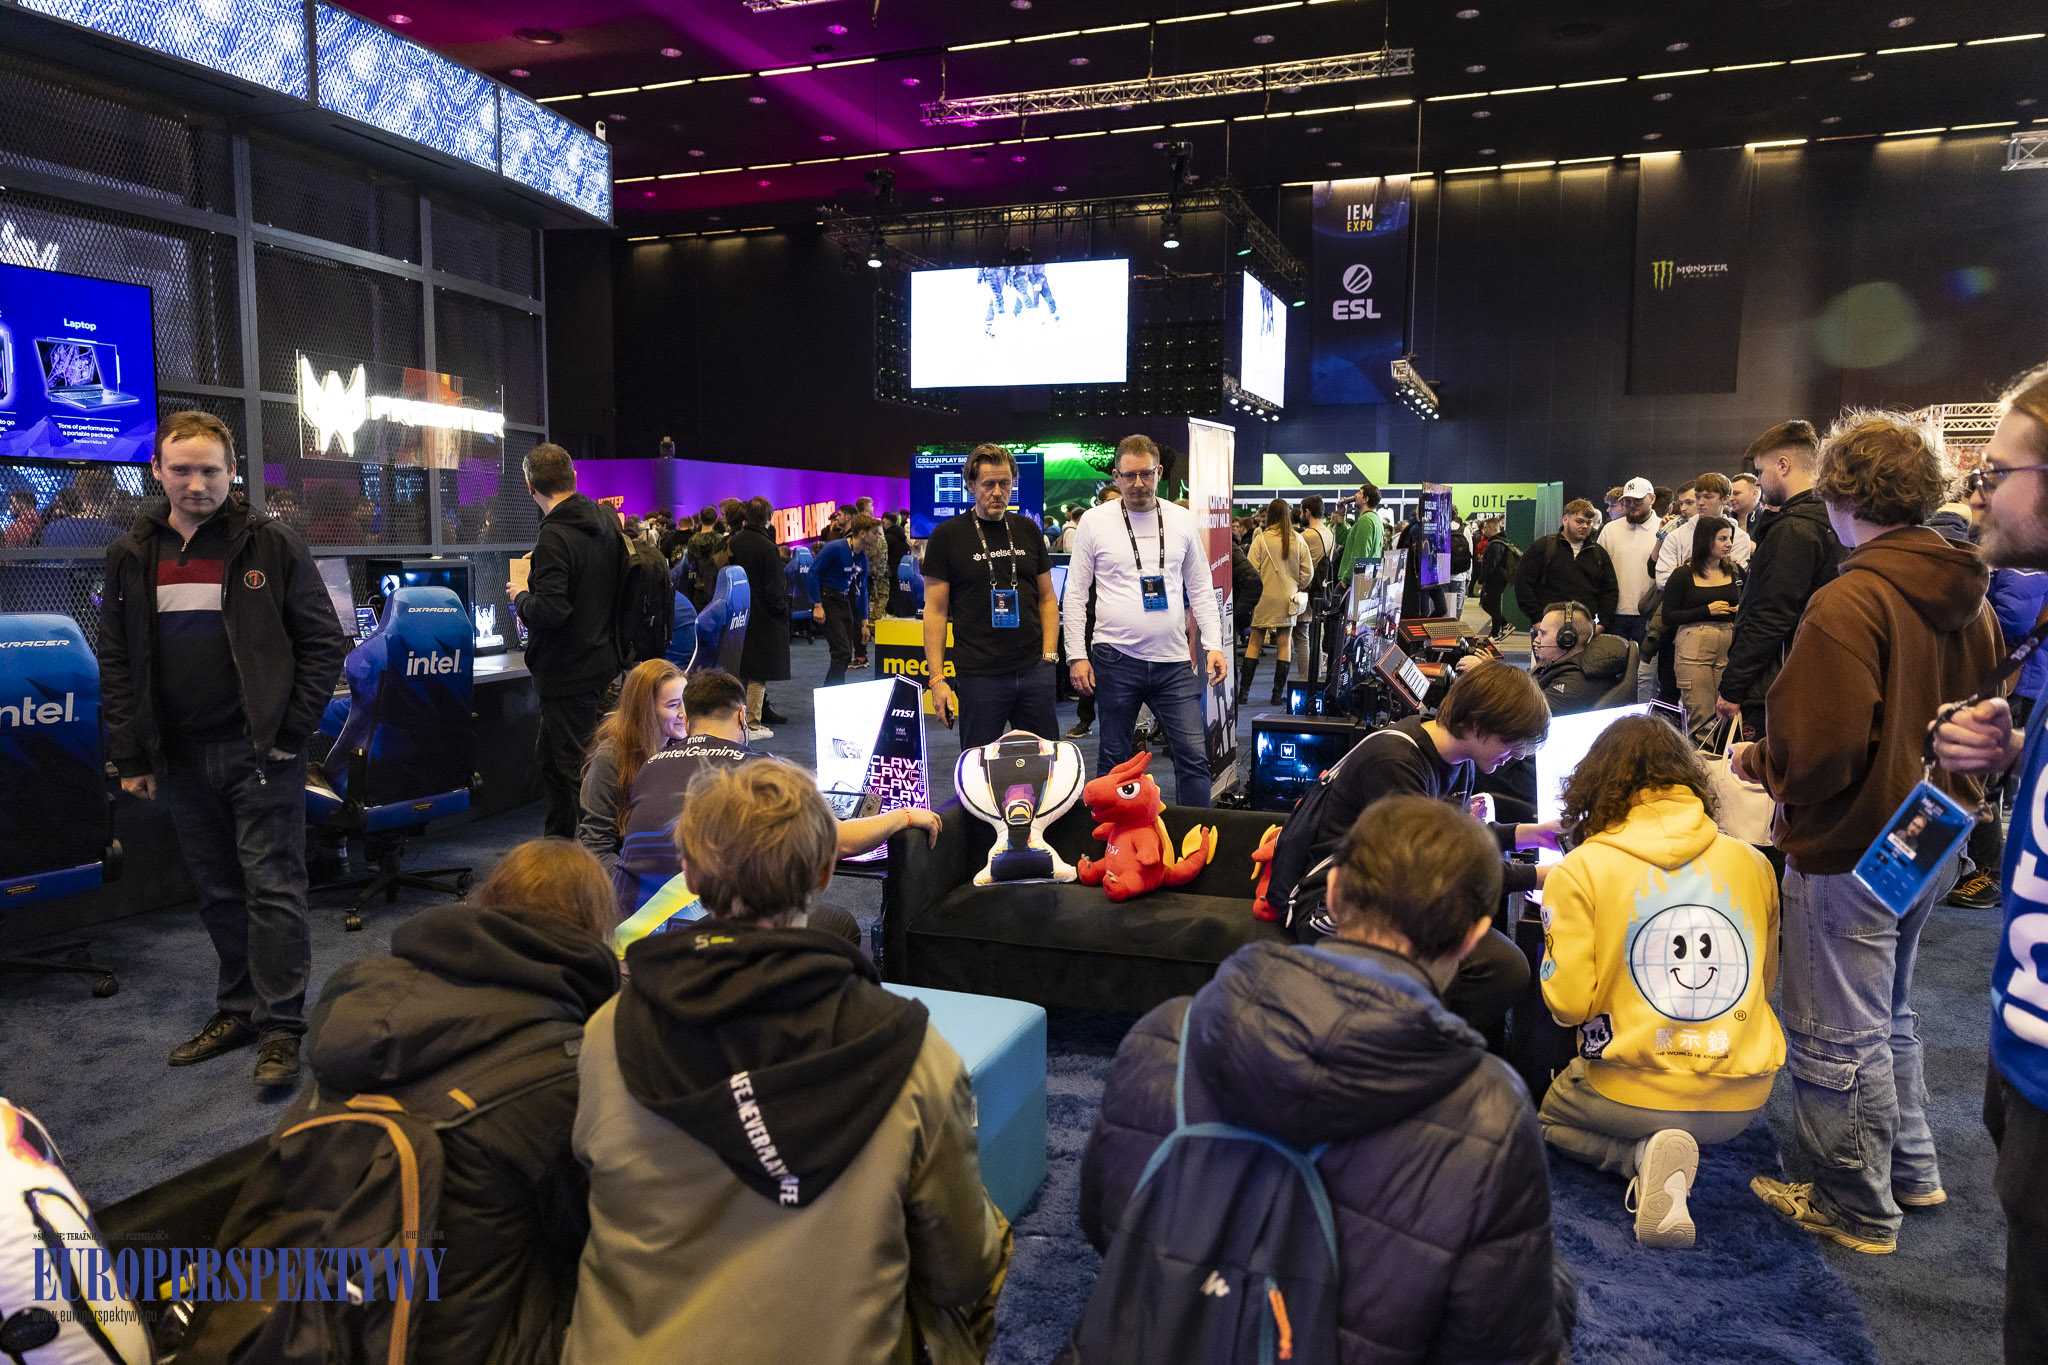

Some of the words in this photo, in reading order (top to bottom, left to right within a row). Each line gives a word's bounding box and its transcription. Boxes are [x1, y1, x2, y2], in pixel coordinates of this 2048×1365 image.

[1347, 204, 1373, 220] IEM
[1347, 220, 1373, 232] EXPO
[1676, 263, 1728, 274] MONSTER
[1332, 298, 1381, 320] ESL
[63, 318, 97, 331] Laptop
[78, 425, 113, 433] performance
[1309, 464, 1331, 475] ESL
[1333, 463, 1352, 475] SHOP
[1472, 495, 1525, 508] OUTL
[891, 708, 915, 718] msi
